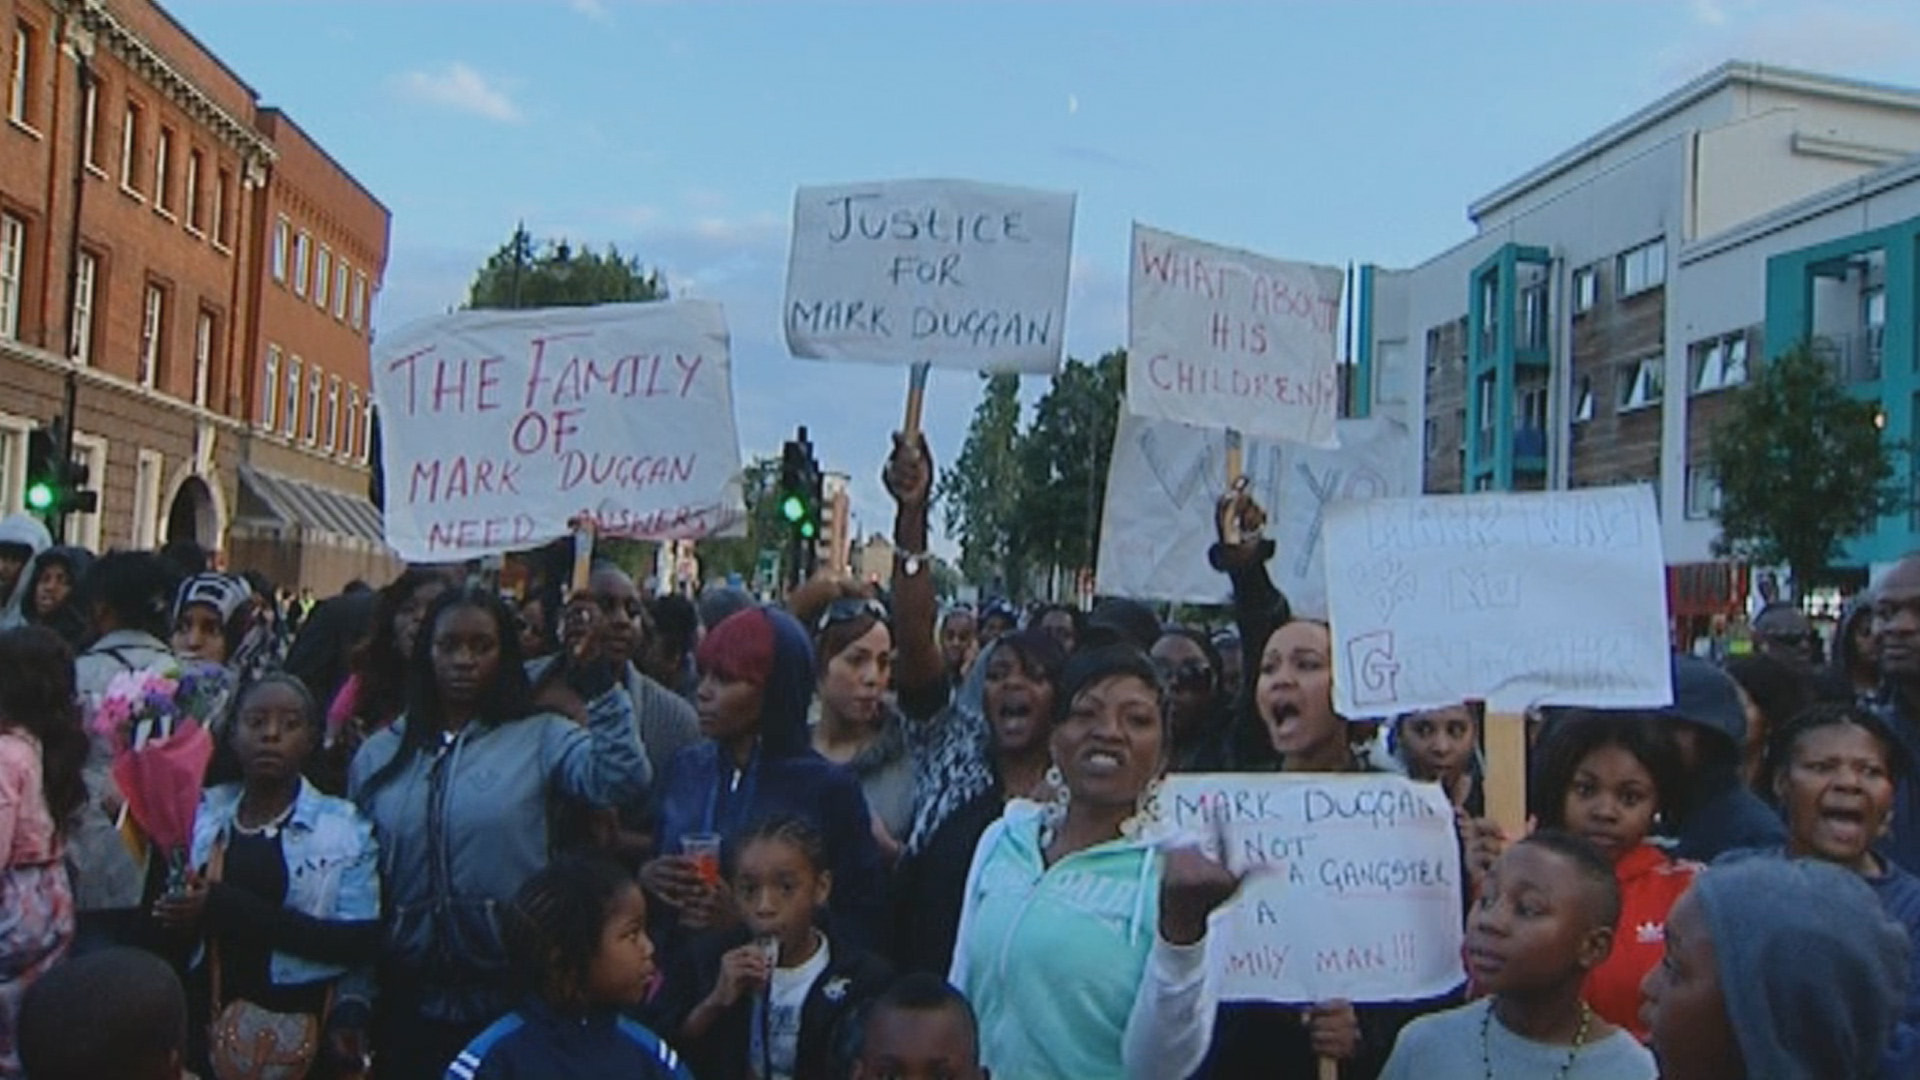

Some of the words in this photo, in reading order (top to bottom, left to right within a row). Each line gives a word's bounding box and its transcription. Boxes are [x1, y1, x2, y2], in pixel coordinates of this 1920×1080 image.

[888, 252, 964, 286] FOR
[1141, 241, 1248, 301] WHAT
[790, 300, 892, 338] MARK
[911, 306, 1052, 346] DUGGAN
[1211, 311, 1268, 355] HIS
[388, 344, 504, 416] THE
[525, 332, 703, 409] FAMILY
[511, 408, 586, 454] OF
[409, 456, 522, 503] MARK
[558, 450, 697, 491] DUGGAN
[428, 513, 536, 552] NEED
[1175, 789, 1281, 826] MARK
[1304, 789, 1435, 826] DUGGAN
[1243, 833, 1316, 863] NOT
[1289, 863, 1304, 883] A
[1256, 900, 1278, 924] A
